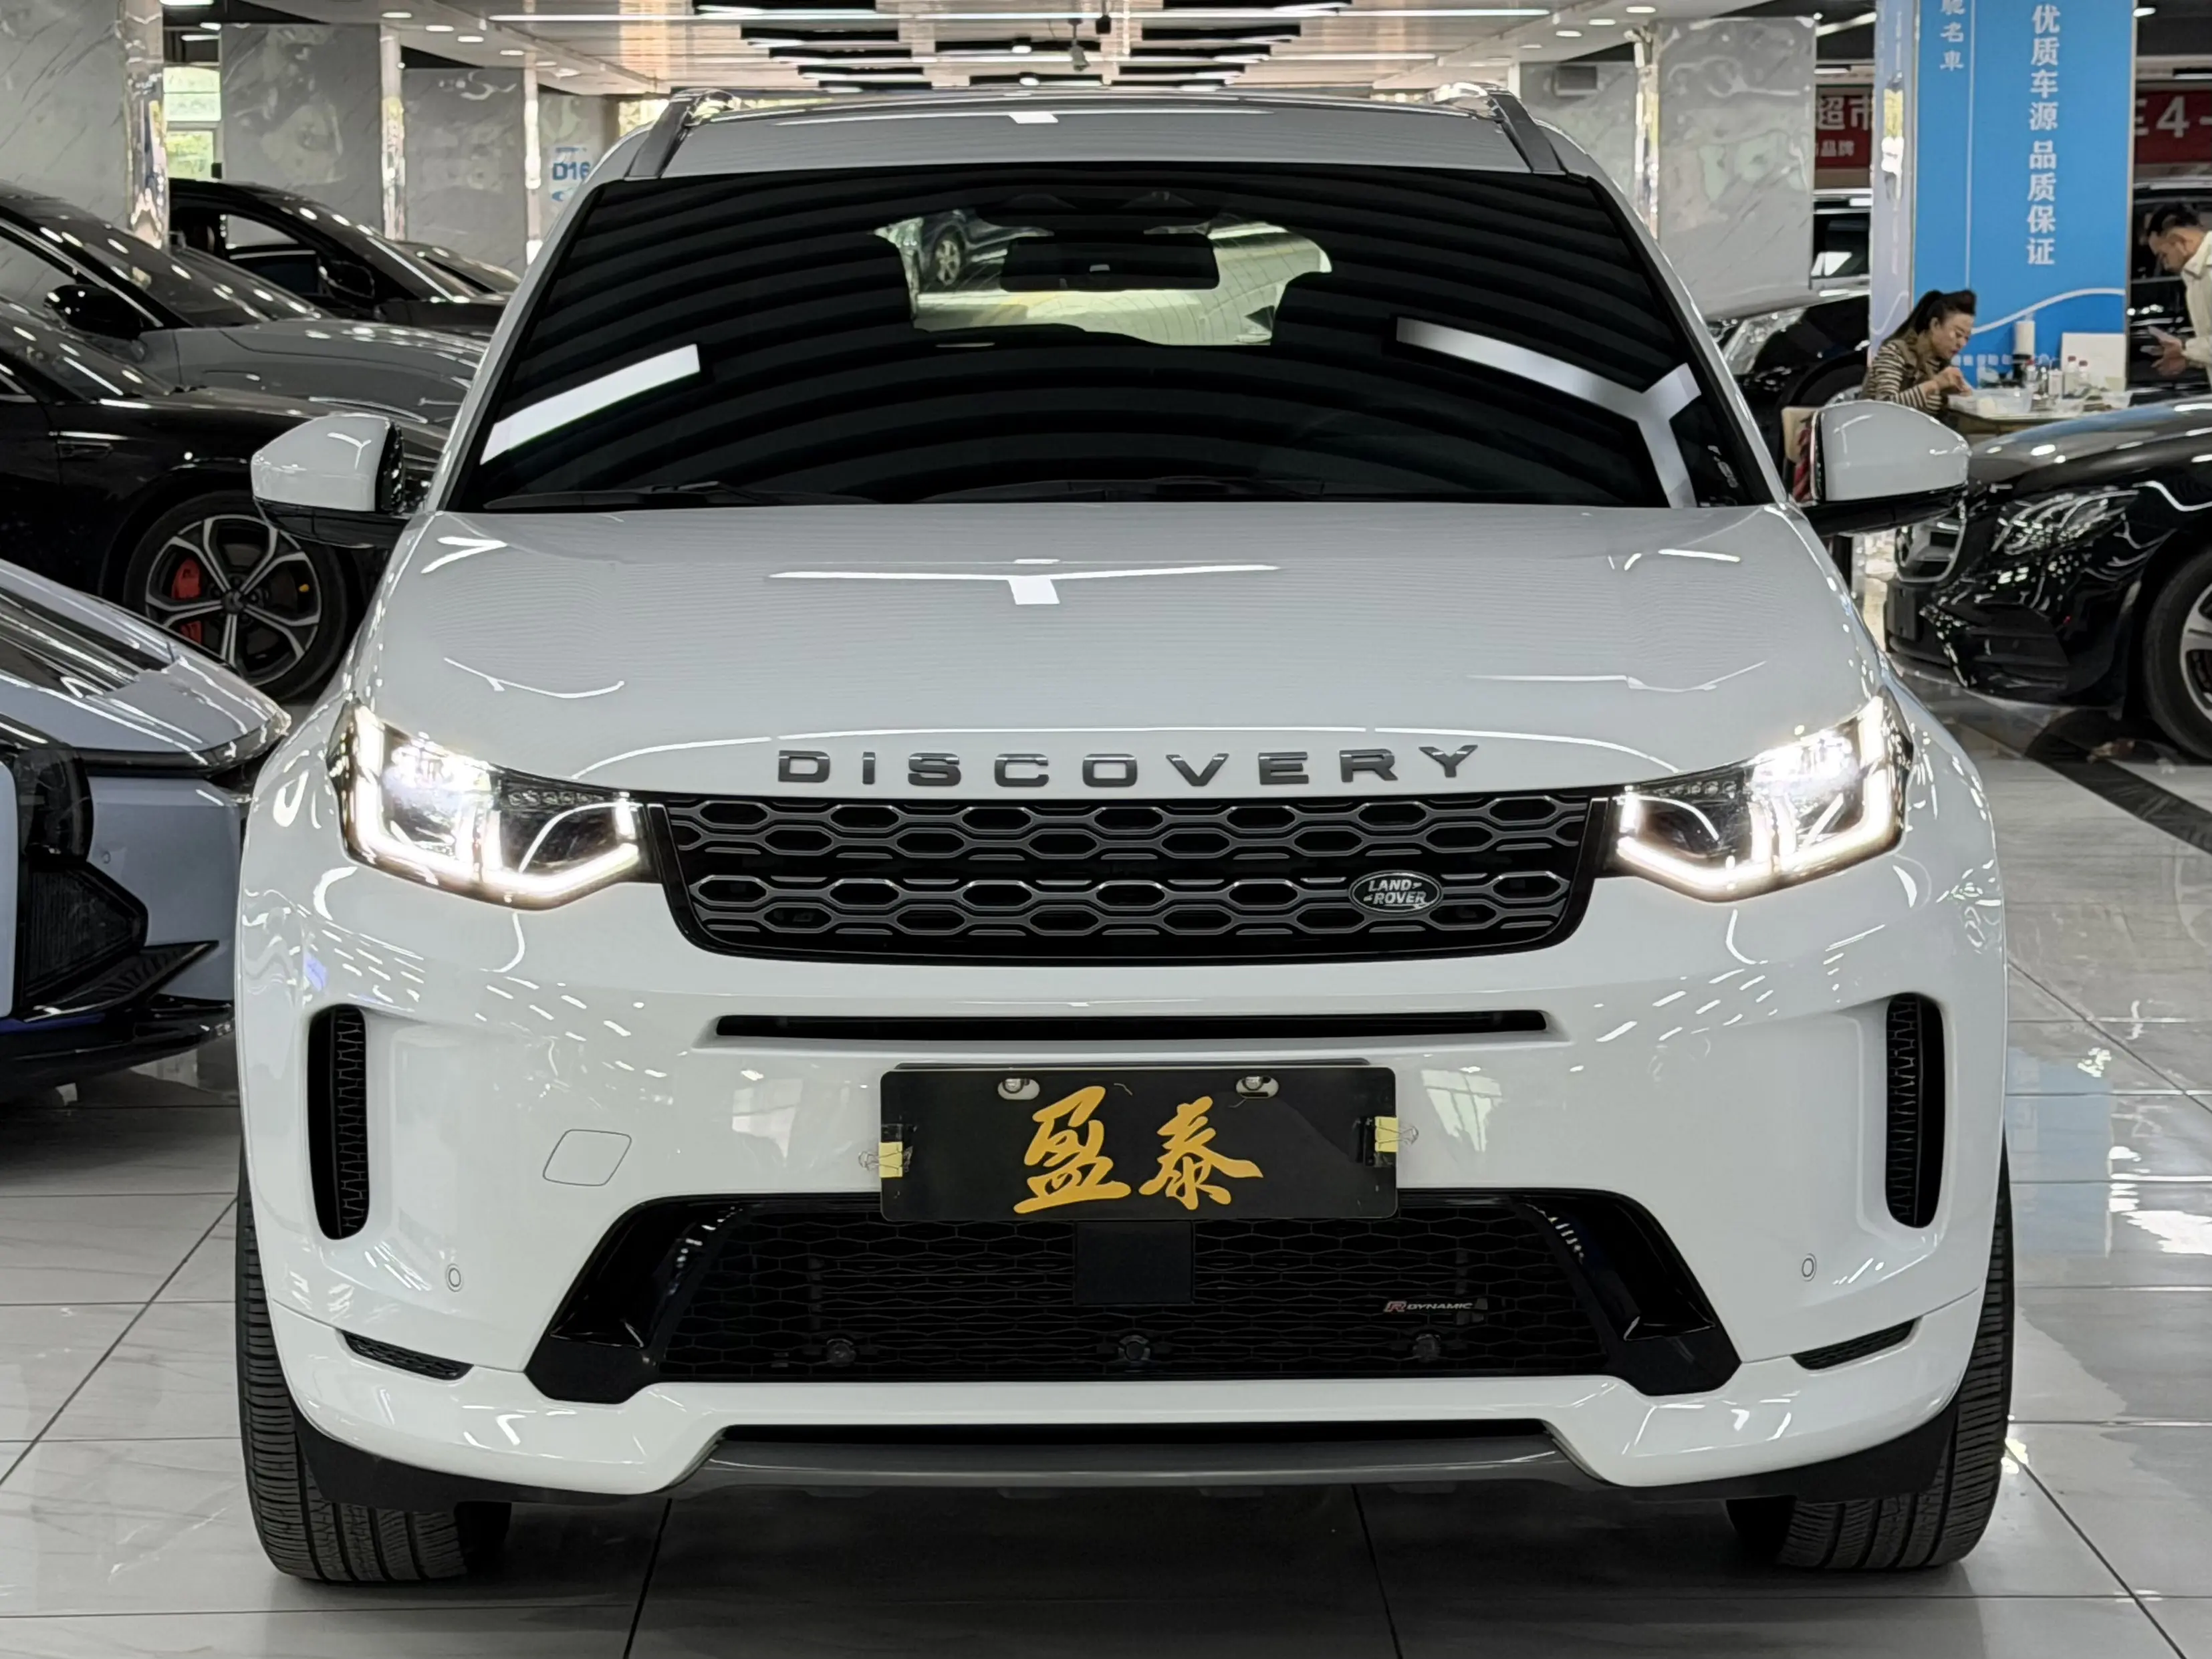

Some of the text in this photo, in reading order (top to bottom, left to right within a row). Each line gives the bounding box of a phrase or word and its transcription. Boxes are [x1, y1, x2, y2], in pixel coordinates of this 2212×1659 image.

[2026, 4, 2061, 265] 优质车源 品质保证
[1816, 140, 1855, 157] 品牌
[552, 162, 591, 180] D16
[778, 744, 1479, 787] DISCOVERY
[1368, 879, 1412, 892] LAND
[1372, 891, 1427, 904] ROVER
[1013, 1086, 1263, 1214] 盈泰
